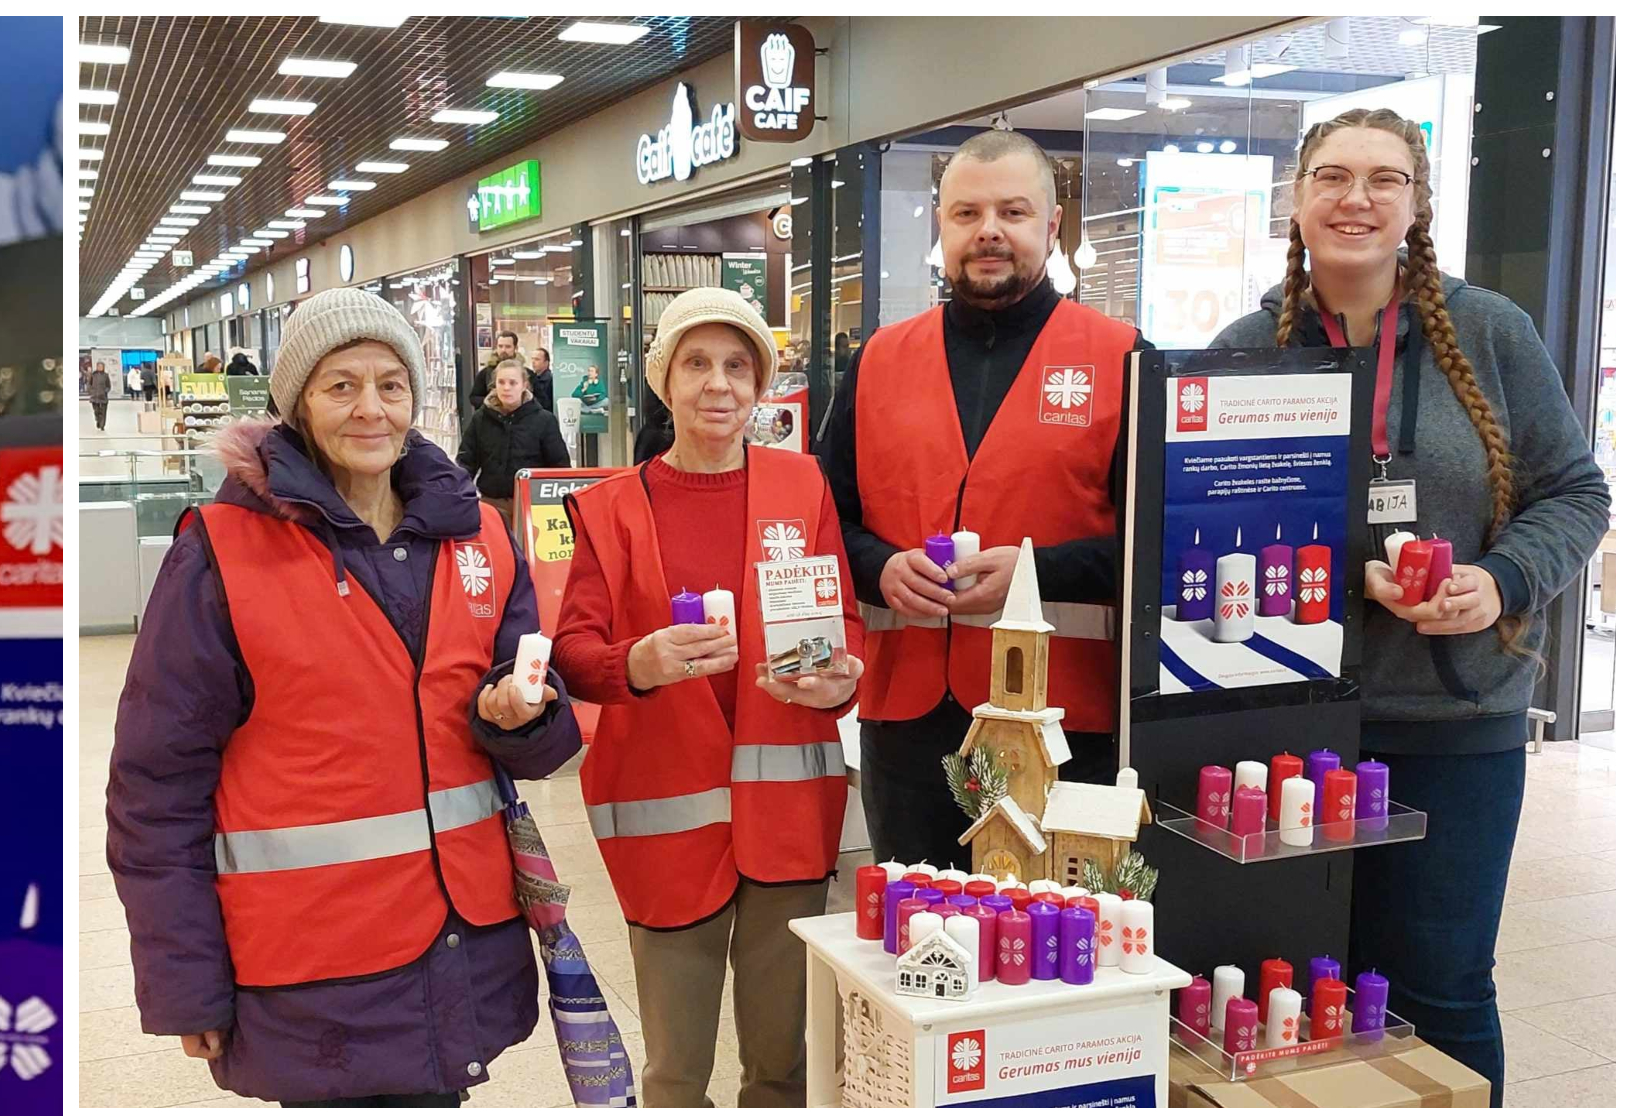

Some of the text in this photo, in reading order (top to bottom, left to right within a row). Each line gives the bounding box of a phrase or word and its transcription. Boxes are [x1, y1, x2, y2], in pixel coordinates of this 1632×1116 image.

[745, 85, 810, 113] CAIF
[754, 112, 798, 130] CAFE
[1256, 398, 1282, 407] CARITO
[1282, 397, 1316, 406] PARAMOS
[1043, 411, 1087, 425] caritas
[1218, 408, 1338, 424] Gerumas mus vienija
[546, 518, 572, 531] Ka
[765, 564, 836, 581] PADĖKITE
[1000, 1034, 1142, 1061] TRADICINĖ CARITO PARAMOS AKCIJA
[1278, 1047, 1300, 1056] MUMS
[998, 1047, 1142, 1080] Gerumas mus vienija
[952, 1072, 981, 1085] caritas
